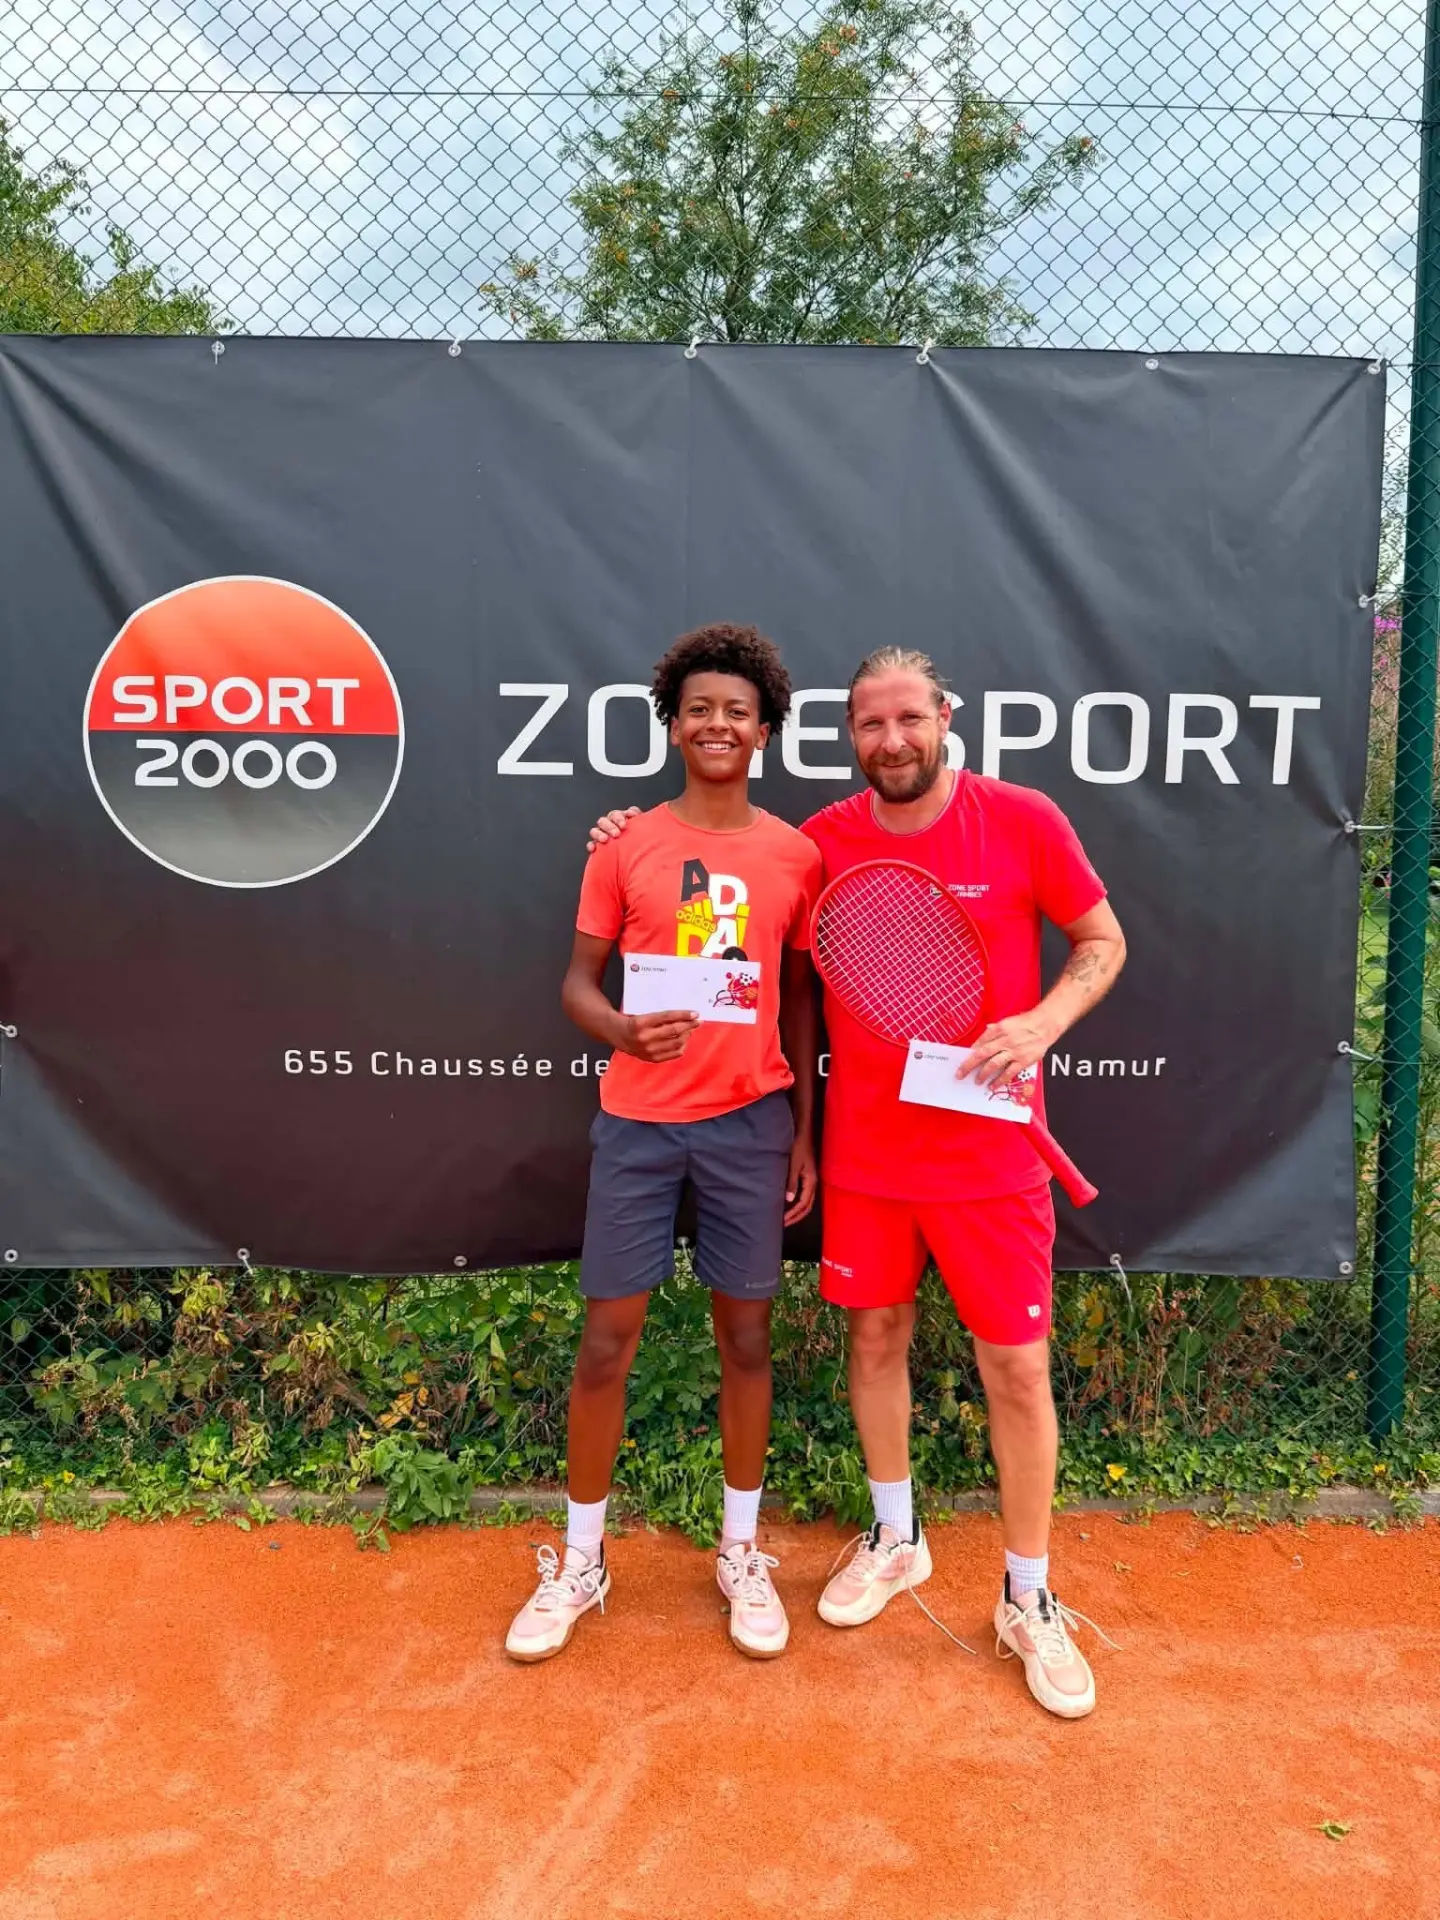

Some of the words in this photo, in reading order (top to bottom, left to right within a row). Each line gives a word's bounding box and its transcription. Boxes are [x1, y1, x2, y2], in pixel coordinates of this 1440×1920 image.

[112, 675, 360, 726] SPORT
[497, 683, 852, 780] ZOE
[134, 738, 338, 790] 2000
[675, 908, 718, 933] adidas
[284, 1050, 353, 1075] 655
[370, 1051, 552, 1077] Chaussée
[570, 1053, 610, 1077] de
[1051, 1053, 1166, 1077] Namur
